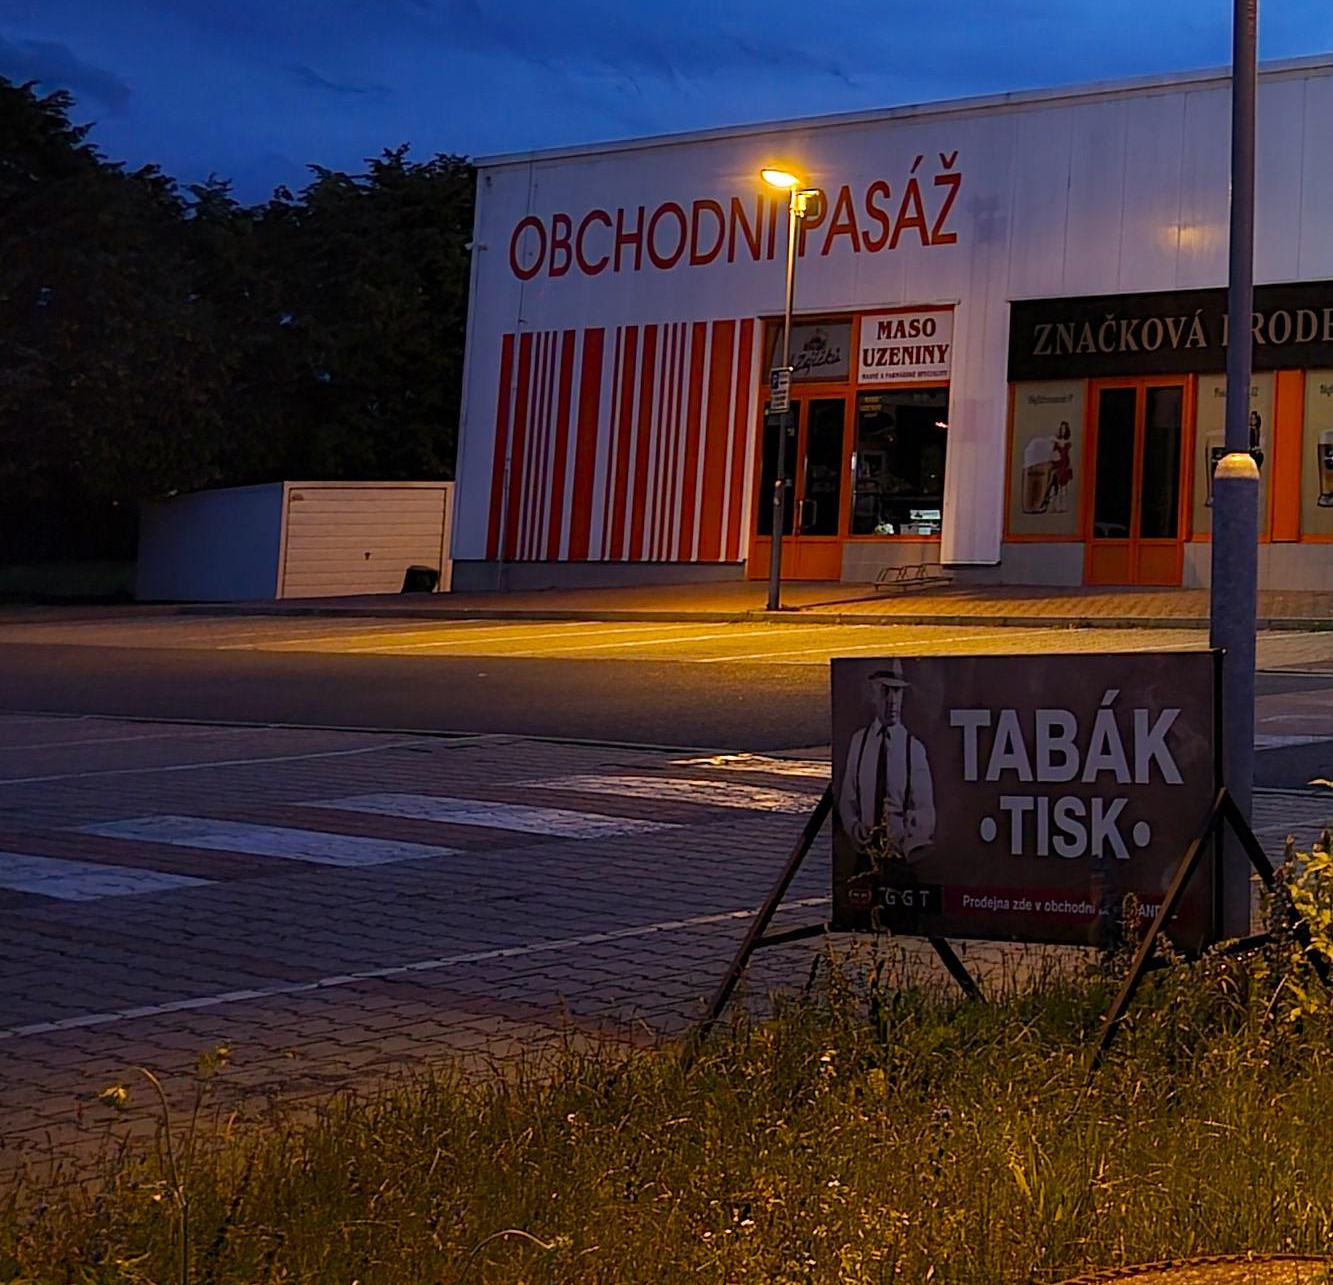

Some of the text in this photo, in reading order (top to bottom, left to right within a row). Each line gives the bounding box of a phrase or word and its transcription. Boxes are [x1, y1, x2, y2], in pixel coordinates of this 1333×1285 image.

[798, 151, 961, 258] PASÁŽ
[877, 318, 936, 340] MASO
[1033, 308, 1207, 356] ZNAČKOVÁ
[862, 344, 949, 367] UZENINY
[950, 689, 1184, 784] TABÁK
[962, 894, 1010, 913] Prodejna
[1012, 897, 1033, 912] zde
[1034, 901, 1042, 912] v
